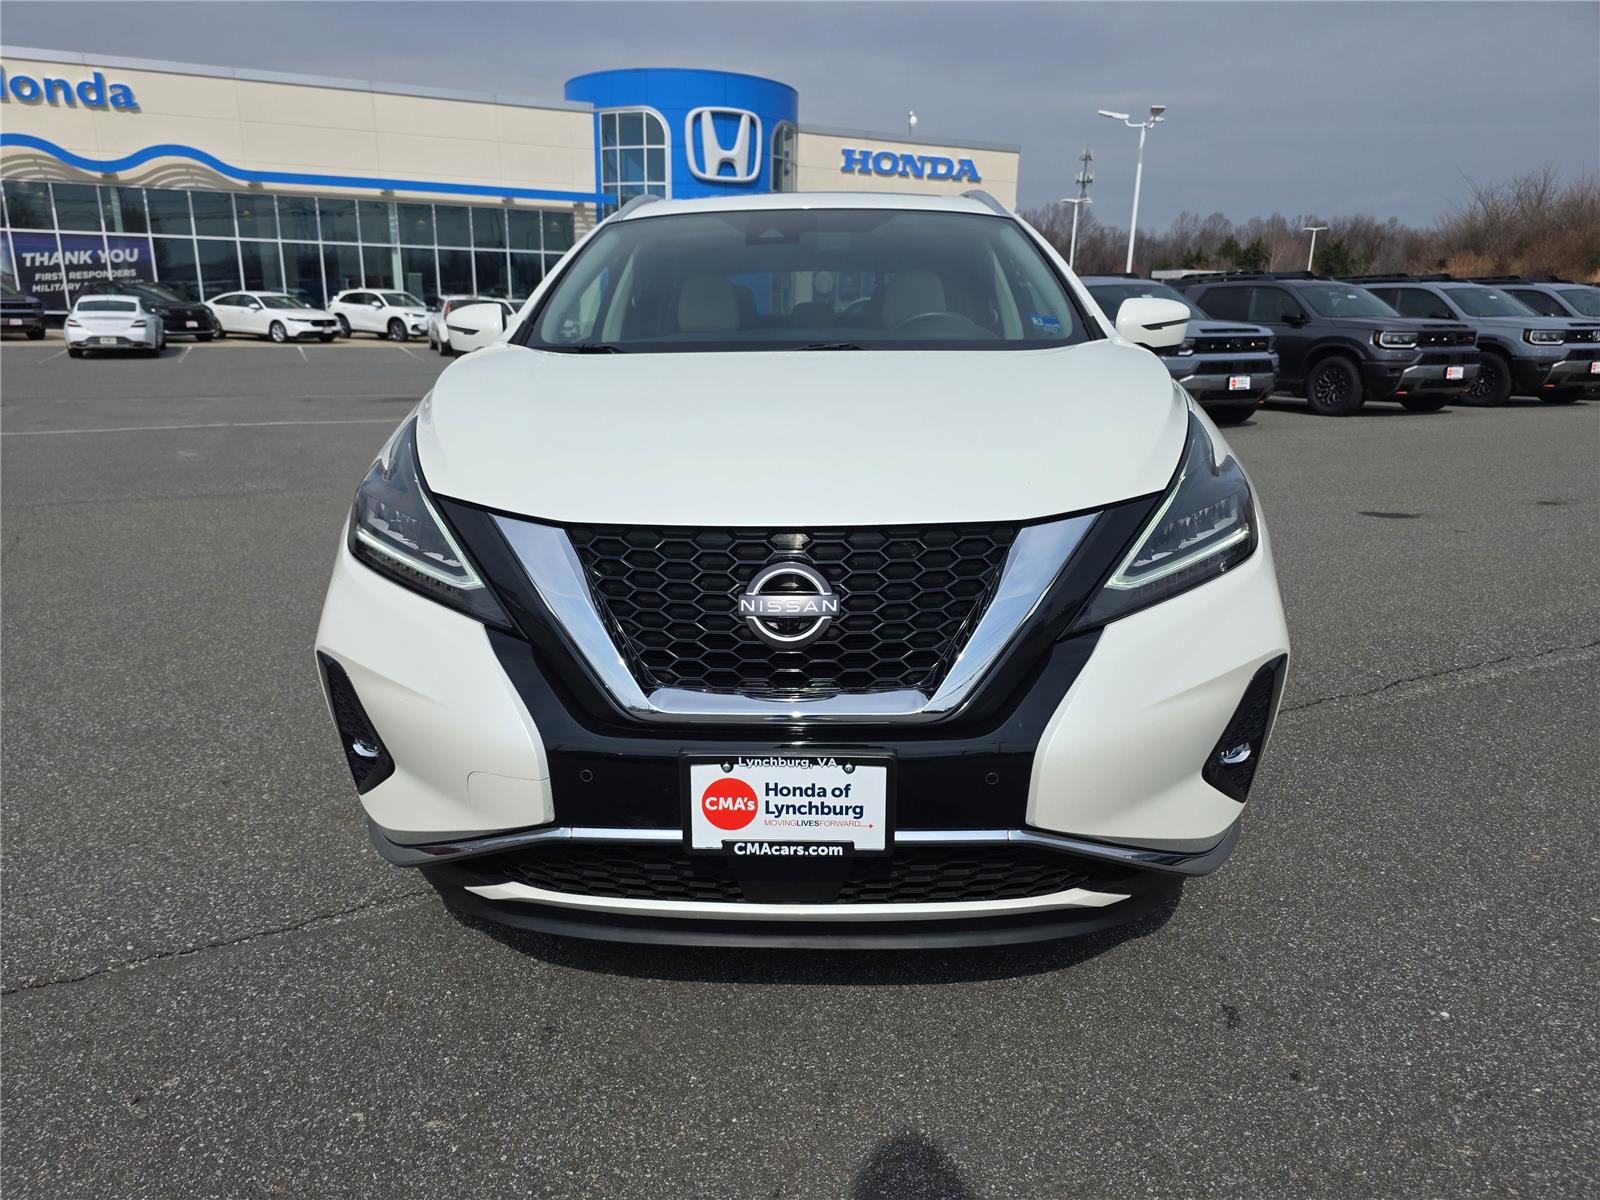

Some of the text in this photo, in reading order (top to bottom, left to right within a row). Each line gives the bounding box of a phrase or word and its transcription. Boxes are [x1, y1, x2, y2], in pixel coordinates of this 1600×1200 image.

[841, 148, 982, 183] HONDA
[22, 248, 139, 267] THANK YOU
[740, 599, 837, 613] NISSAN
[738, 756, 838, 769] Lynchburg, VA
[764, 782, 852, 798] Honda of
[705, 796, 755, 811] CMA's
[764, 800, 864, 819] Lynchburg
[734, 842, 843, 856] CMAcars.com
